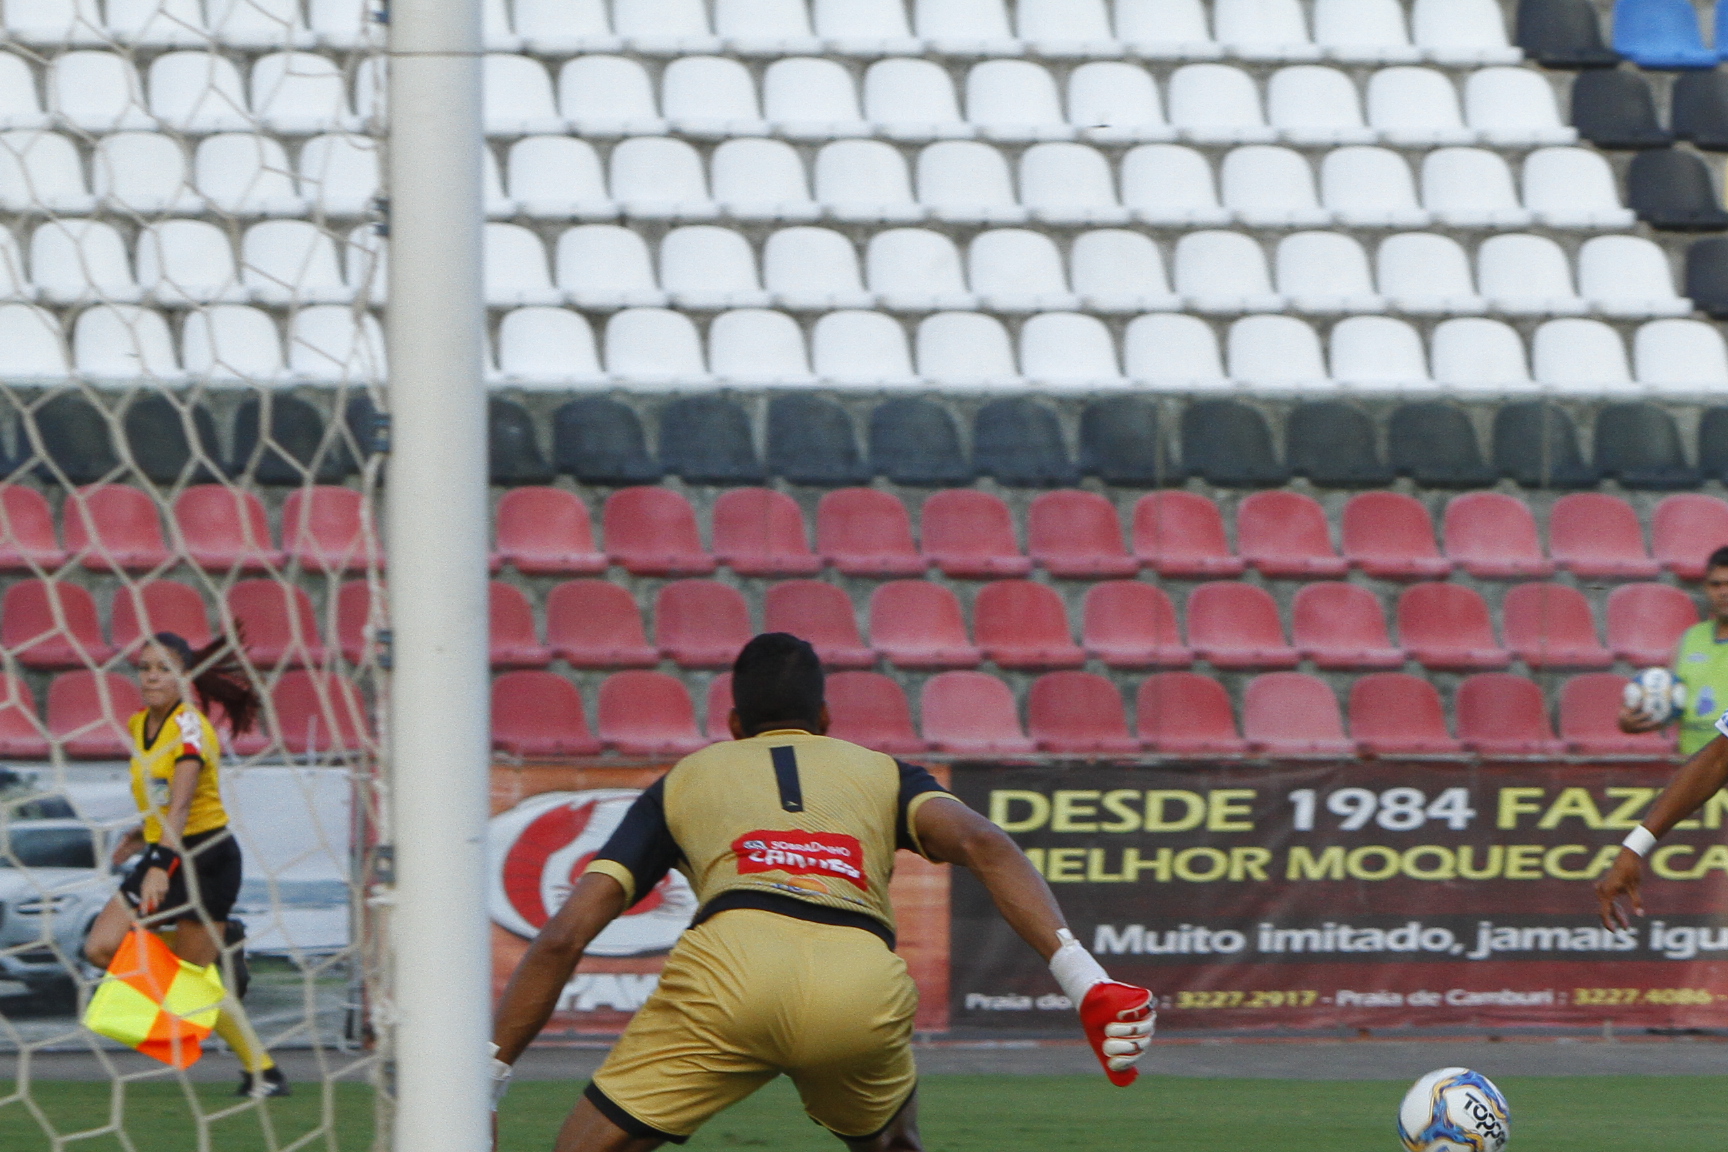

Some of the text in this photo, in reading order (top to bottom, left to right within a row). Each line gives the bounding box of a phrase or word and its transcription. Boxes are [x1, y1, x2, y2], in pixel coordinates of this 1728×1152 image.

[769, 746, 804, 813] 1
[989, 789, 1257, 833] DESDE
[1288, 787, 1477, 831] 1984
[1095, 923, 1246, 955] Muito
[1257, 921, 1465, 955] imitado,
[1466, 920, 1640, 960] jamais
